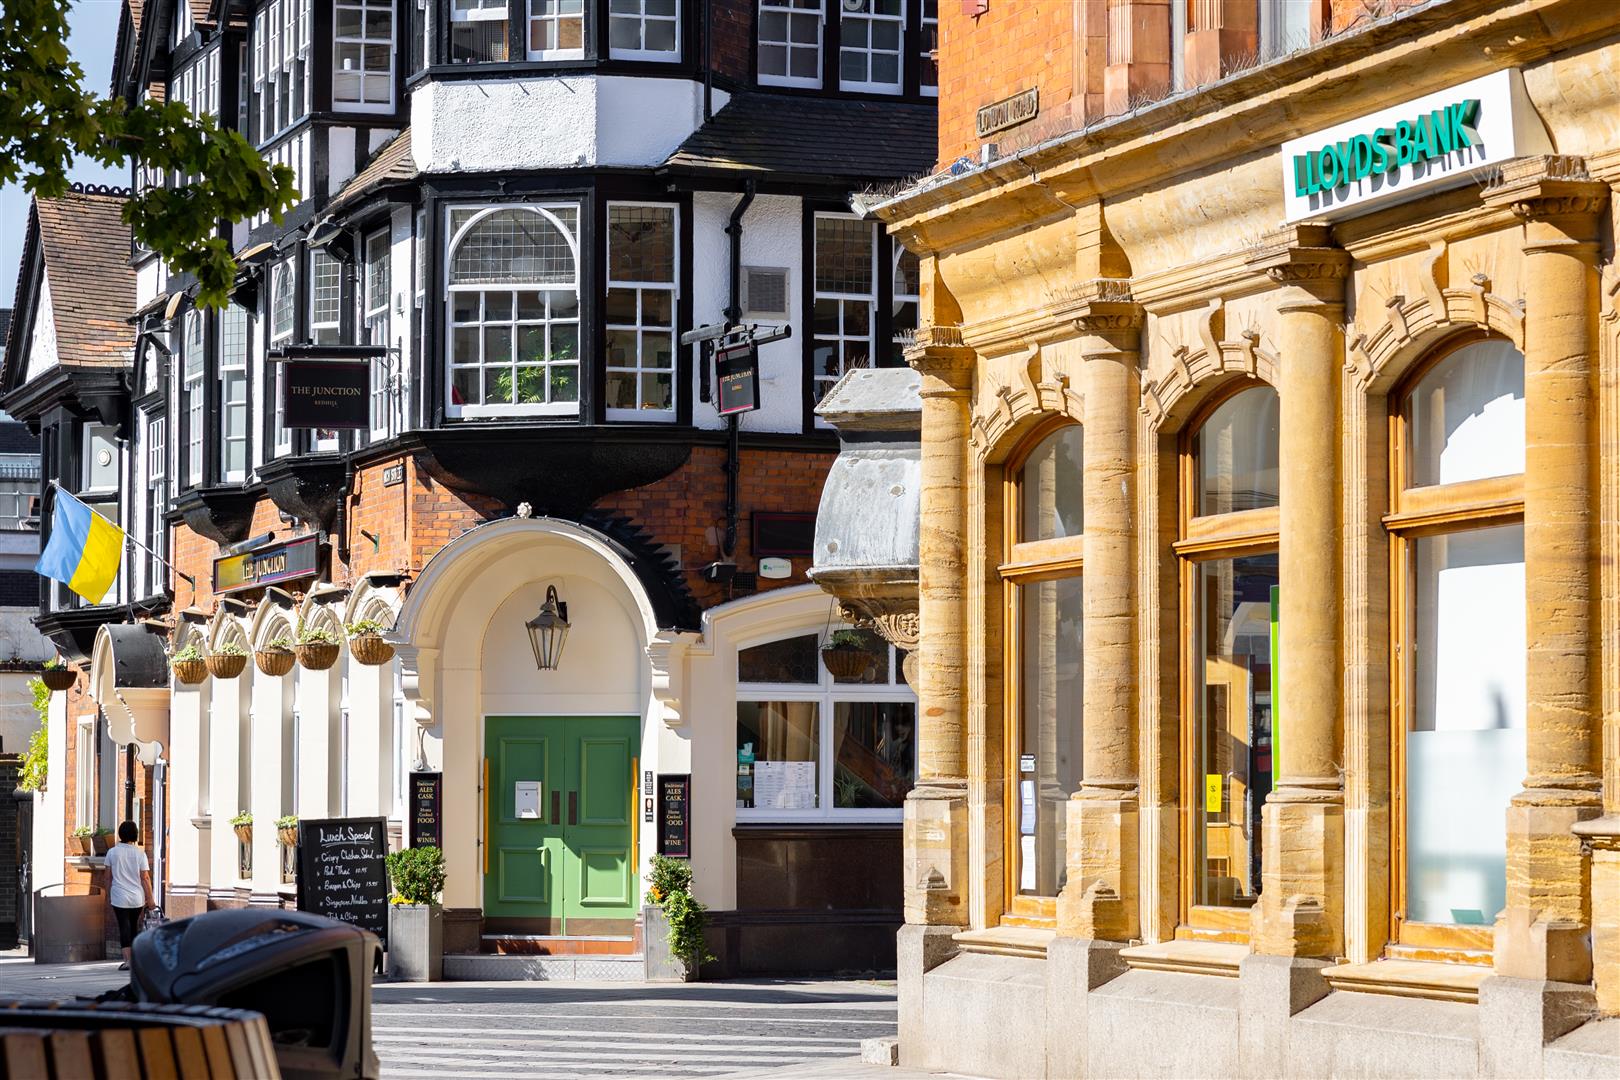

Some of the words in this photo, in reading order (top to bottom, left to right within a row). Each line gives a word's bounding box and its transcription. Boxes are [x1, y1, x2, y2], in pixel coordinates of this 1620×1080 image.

[979, 101, 1009, 132] LONDON
[1013, 94, 1035, 120] ROAD
[1293, 127, 1391, 198] LLOYDS
[1396, 99, 1480, 167] BANK
[291, 386, 311, 395] THE
[311, 386, 361, 397] JUNCTION
[243, 559, 255, 580] THE
[255, 553, 286, 582] JUNCTION
[319, 826, 346, 842] Lunch
[347, 826, 374, 844] Special
[321, 852, 340, 864] Crispy
[340, 848, 361, 860] Chicken
[360, 847, 375, 860] Salad
[323, 865, 335, 876] Pad
[335, 865, 351, 875] Thai
[346, 878, 361, 890] Chips
[325, 896, 352, 908] Singapore
[350, 894, 369, 905] Noodles
[344, 911, 359, 922] Chips
